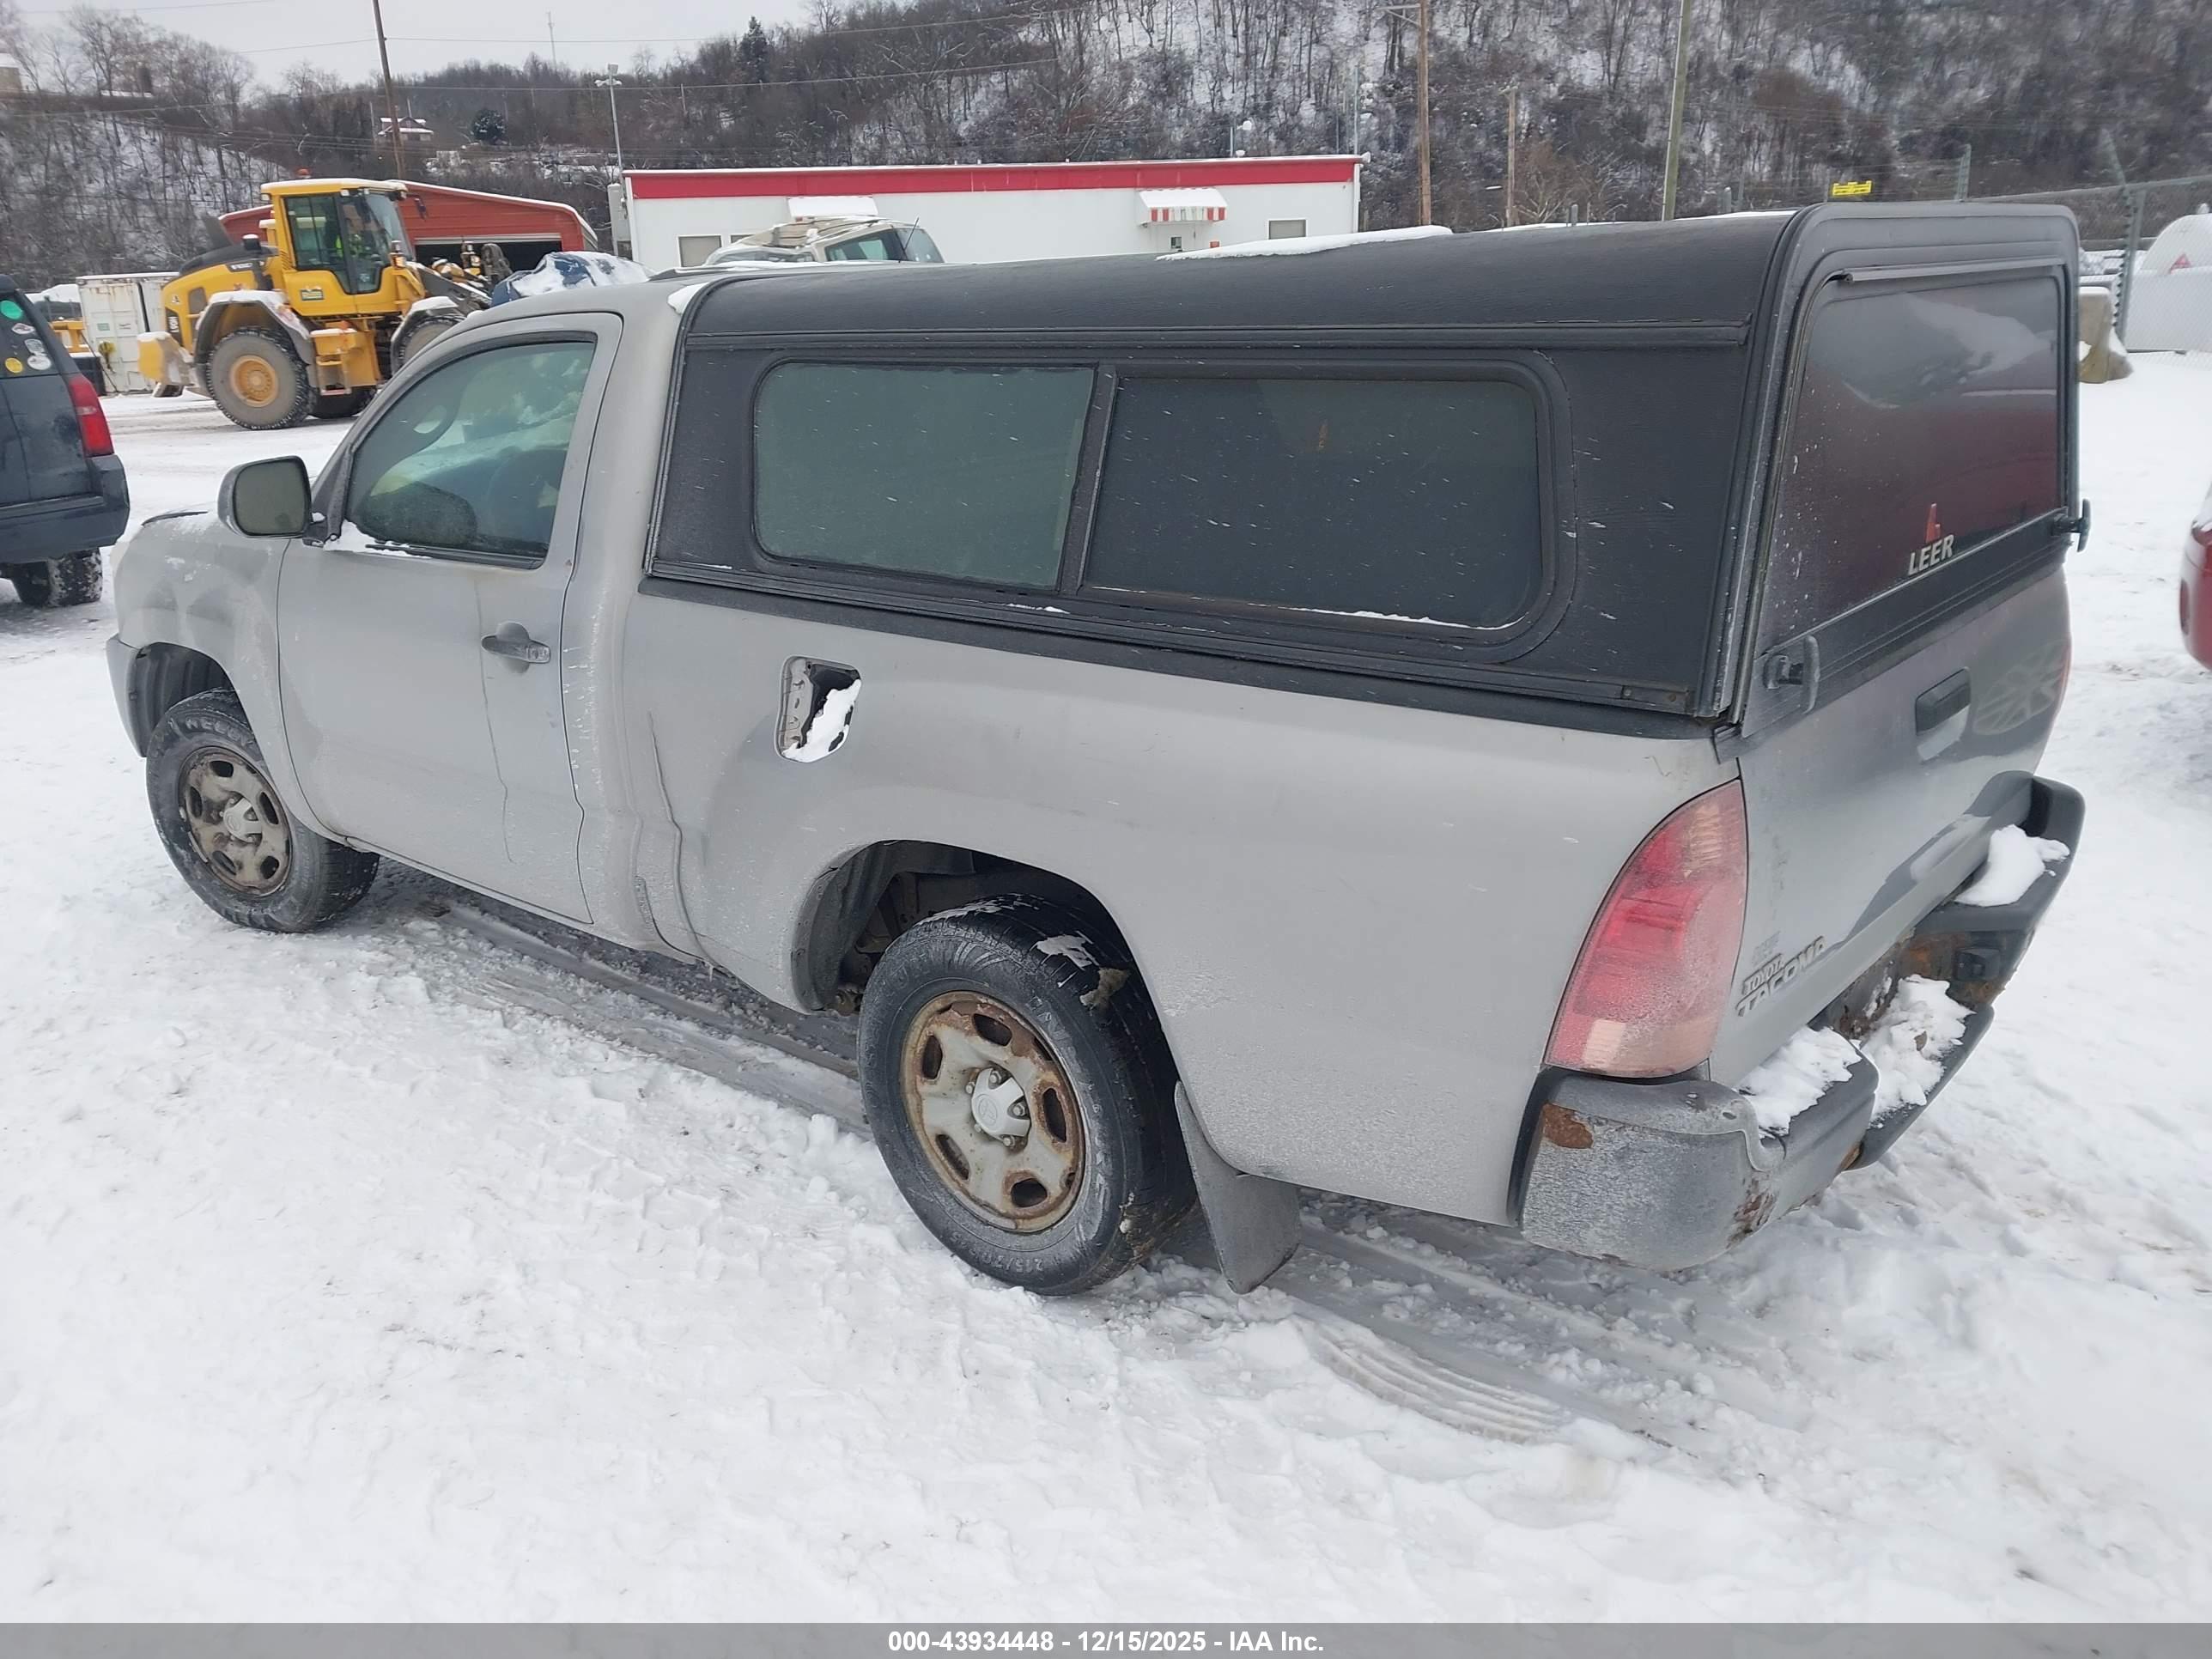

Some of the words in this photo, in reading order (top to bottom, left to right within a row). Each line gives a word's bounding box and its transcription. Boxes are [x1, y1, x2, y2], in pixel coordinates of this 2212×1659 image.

[1908, 534, 1954, 576] LEER
[1735, 935, 1826, 1018] TACOMA
[1742, 953, 1783, 994] TOYOTA
